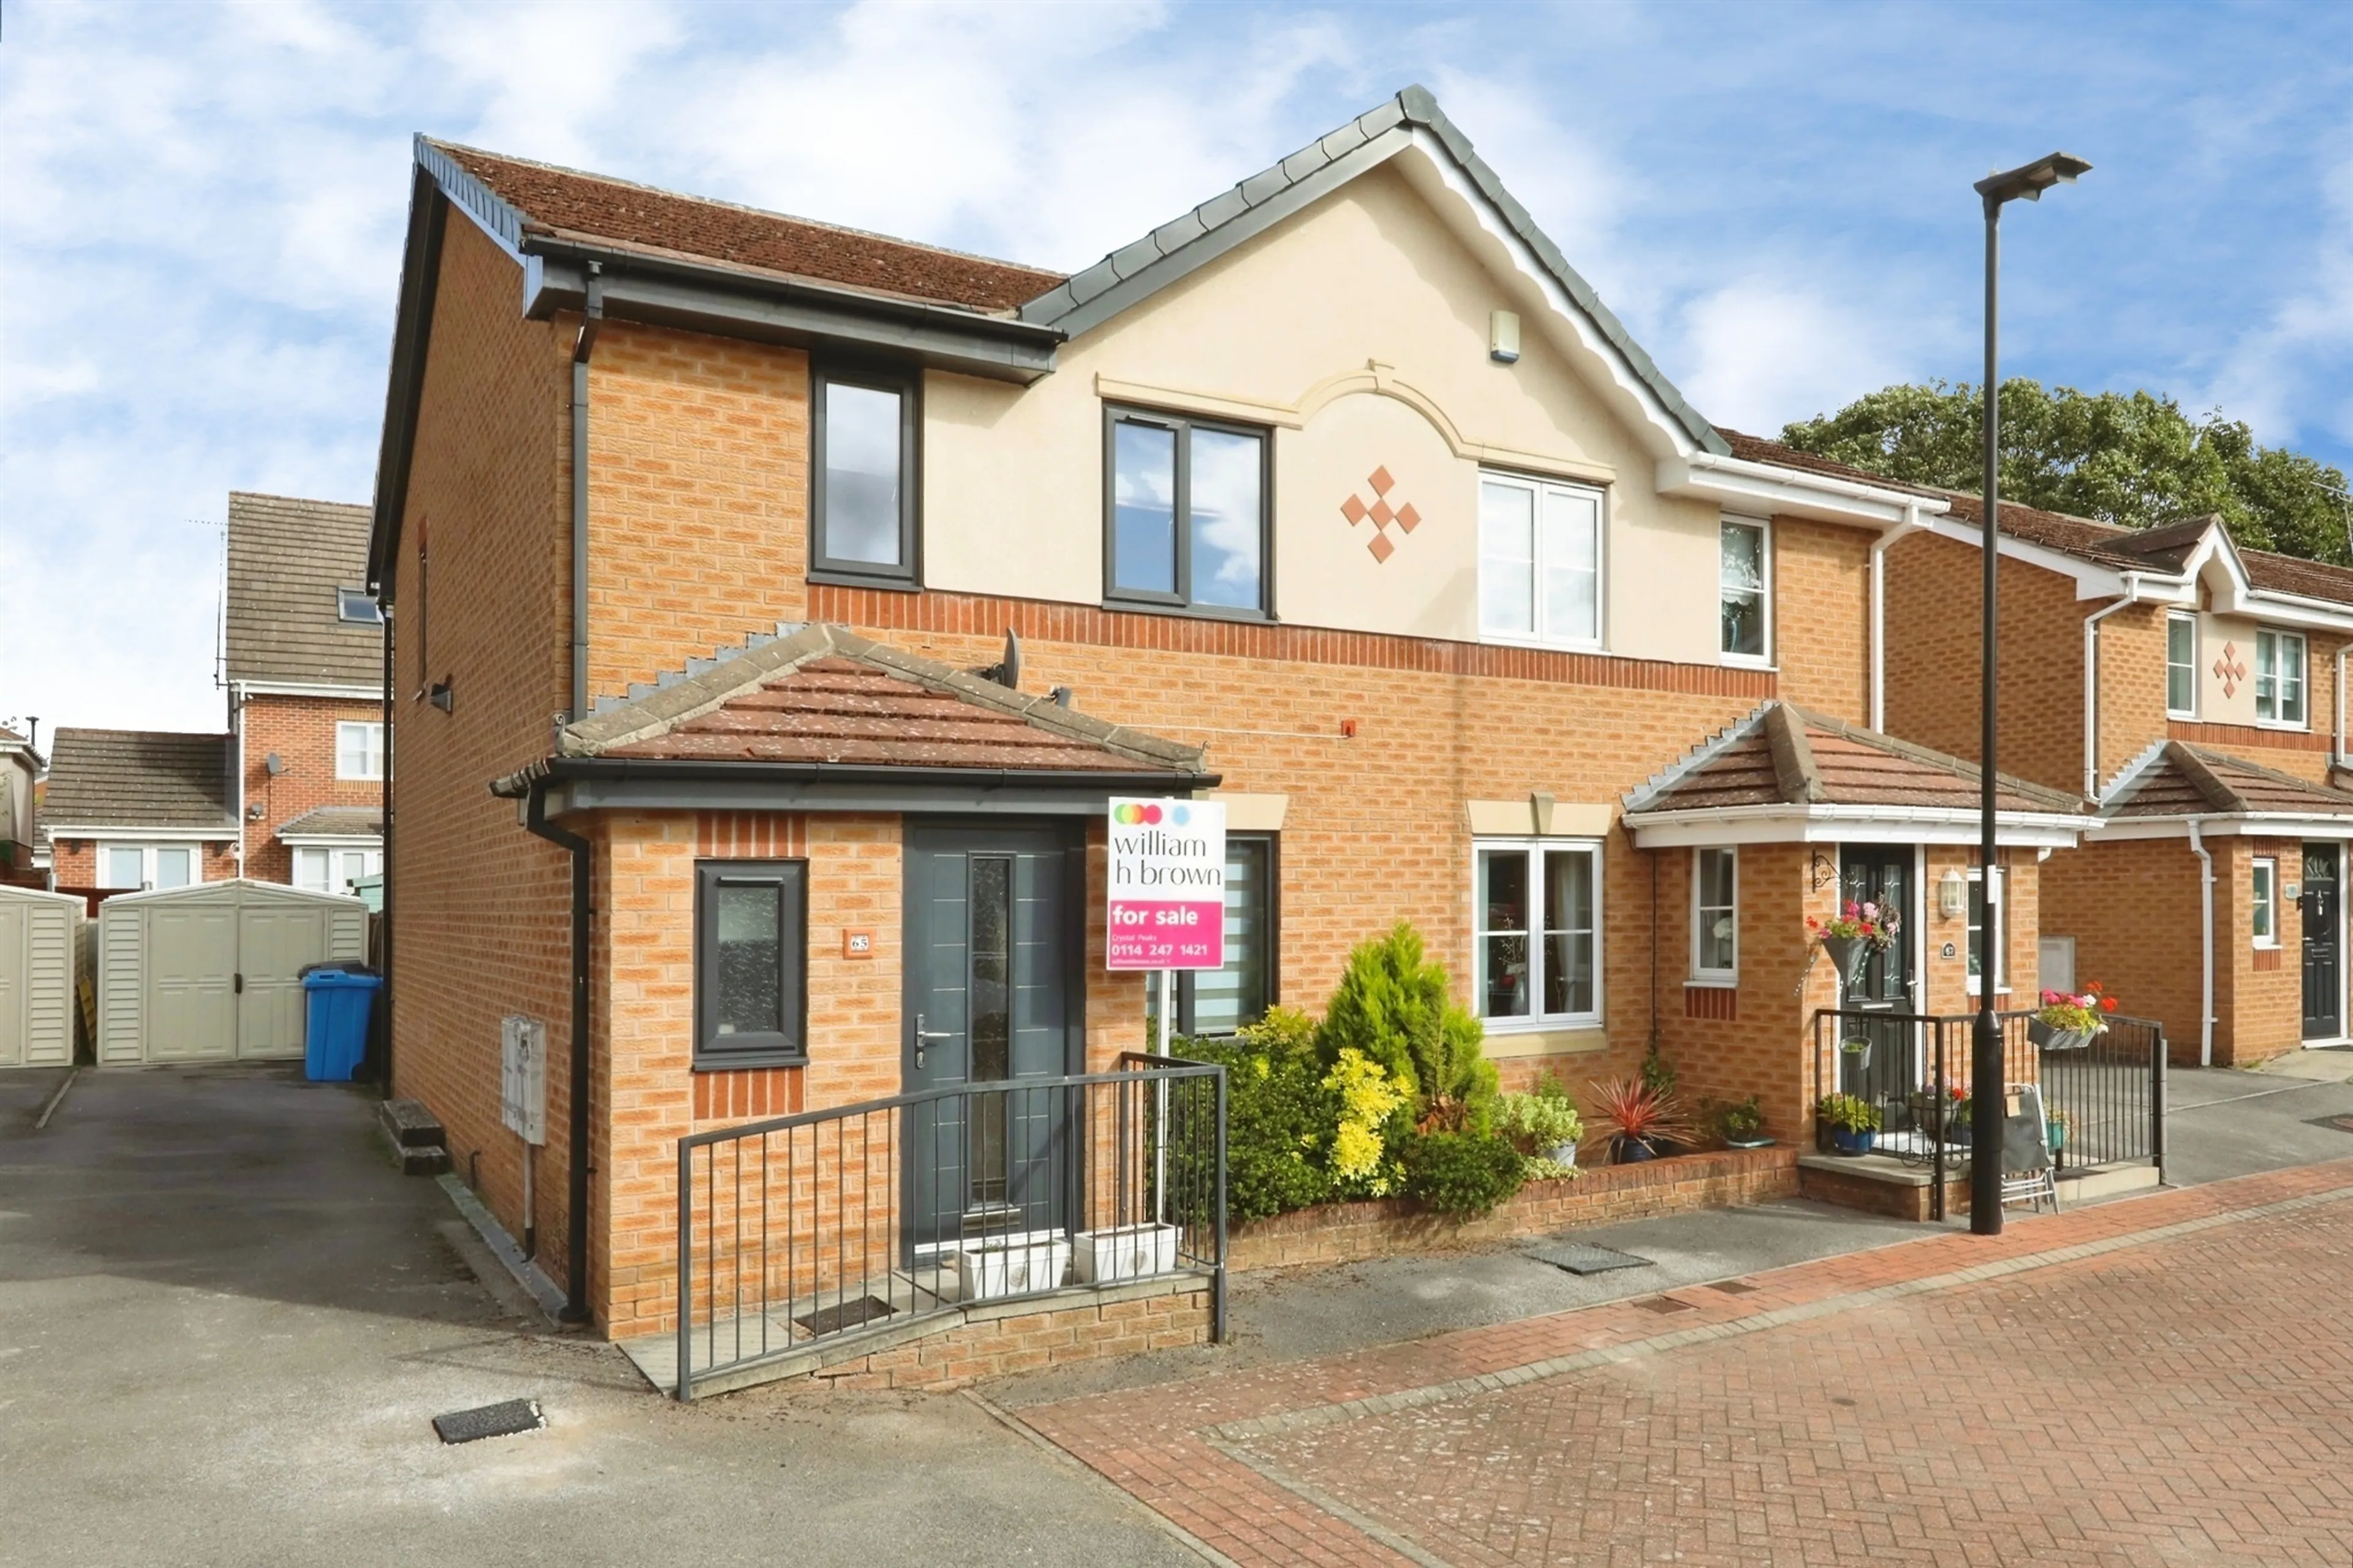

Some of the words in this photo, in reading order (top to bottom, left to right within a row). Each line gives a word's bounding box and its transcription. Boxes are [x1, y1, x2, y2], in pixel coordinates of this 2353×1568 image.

[1115, 830, 1206, 857] william
[1116, 859, 1131, 884] h
[1140, 859, 1221, 885] brown
[1112, 904, 1148, 925] for
[1155, 905, 1199, 925] sale
[852, 939, 868, 947] 65
[1112, 944, 1143, 956] 0114
[1149, 944, 1173, 956] 247
[1180, 944, 1208, 956] 1421
